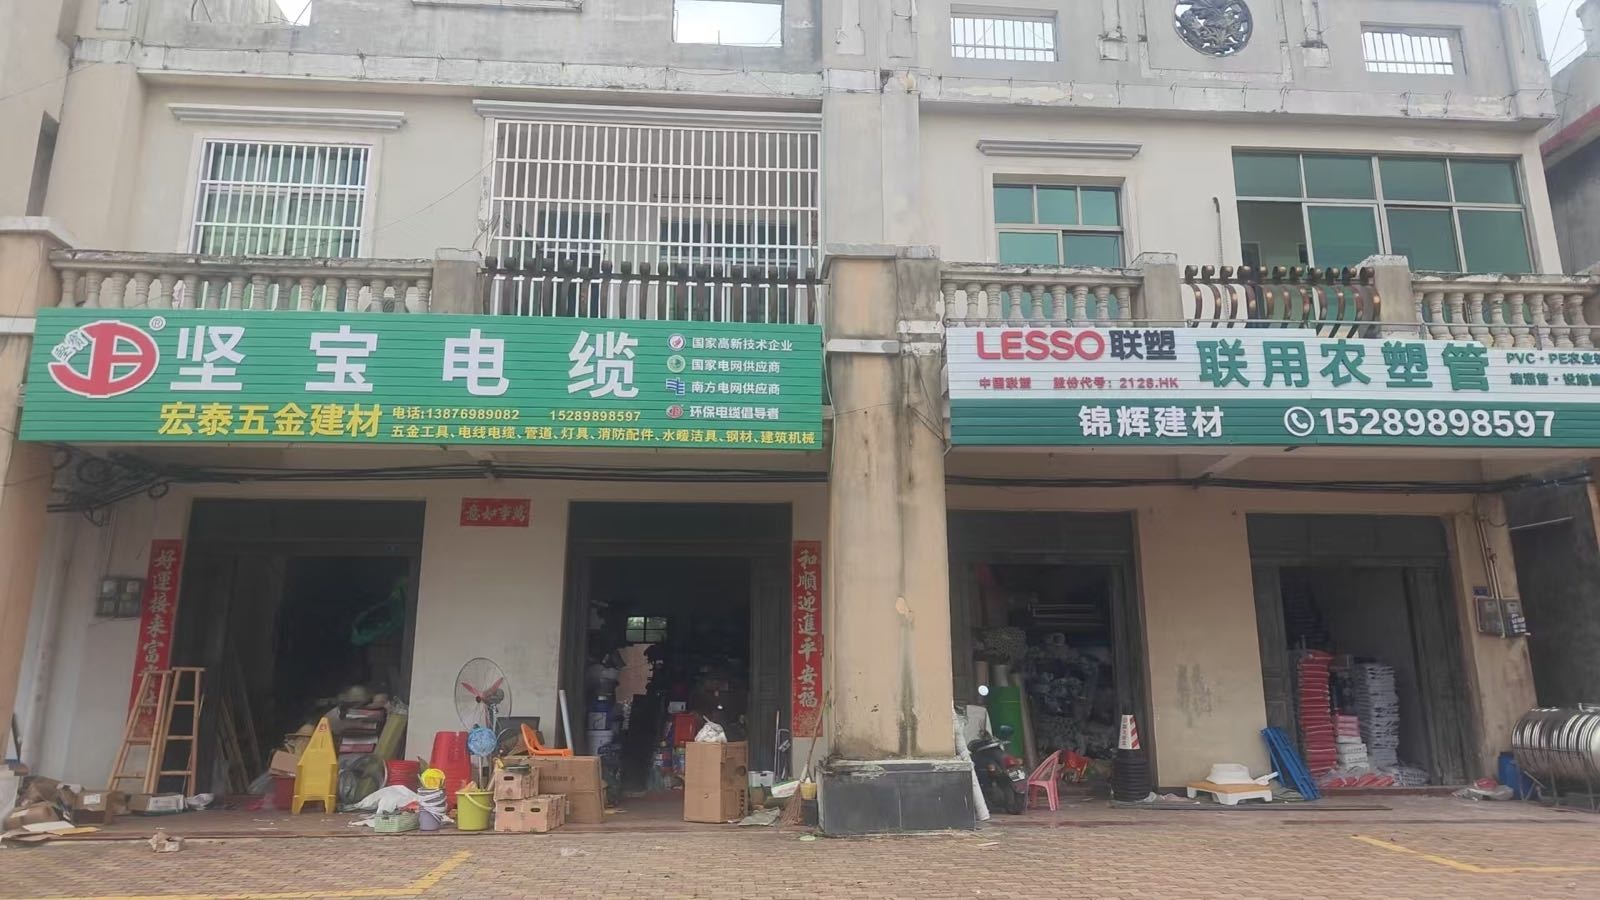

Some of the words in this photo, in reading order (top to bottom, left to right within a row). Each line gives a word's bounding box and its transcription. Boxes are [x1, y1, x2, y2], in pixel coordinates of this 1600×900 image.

[692, 336, 793, 352] 国家高新技术企业
[170, 325, 639, 399] 坚宝电缆
[691, 358, 781, 374] 国家电网供应商
[1196, 338, 1490, 392] 联用农塑管
[691, 381, 780, 396] 南方电网供应商
[158, 401, 382, 438] 宏泰五金建材
[549, 409, 641, 422] 15289898597
[690, 405, 780, 420] 环保电缆倡导者
[1078, 406, 1225, 438] 锦辉建材
[1320, 408, 1556, 438] 15289898597
